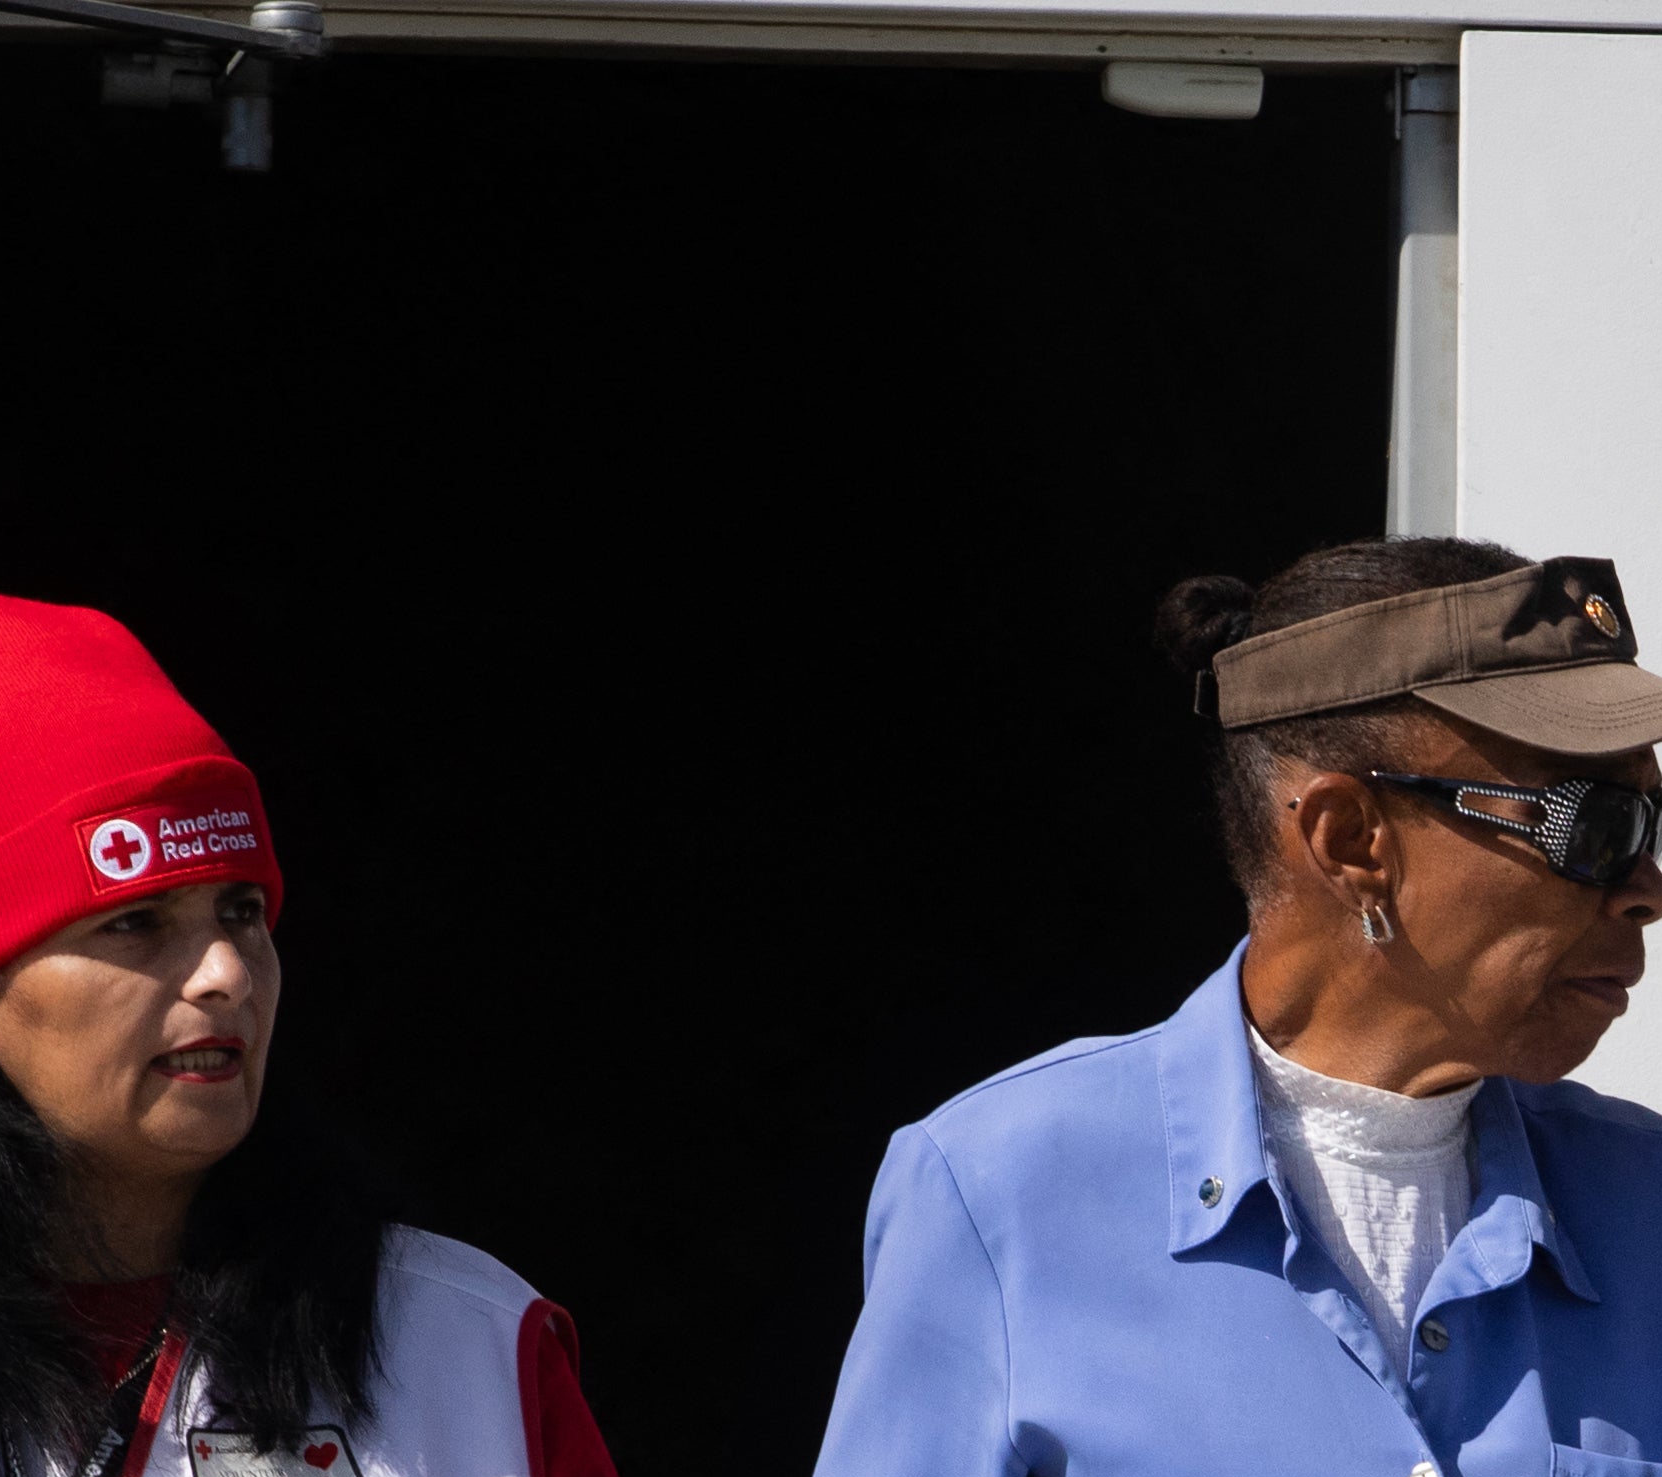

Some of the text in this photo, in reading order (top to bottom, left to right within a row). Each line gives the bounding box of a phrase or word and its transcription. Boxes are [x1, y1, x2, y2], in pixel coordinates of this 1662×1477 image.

[158, 808, 251, 841] American
[162, 832, 258, 863] Red Cross
